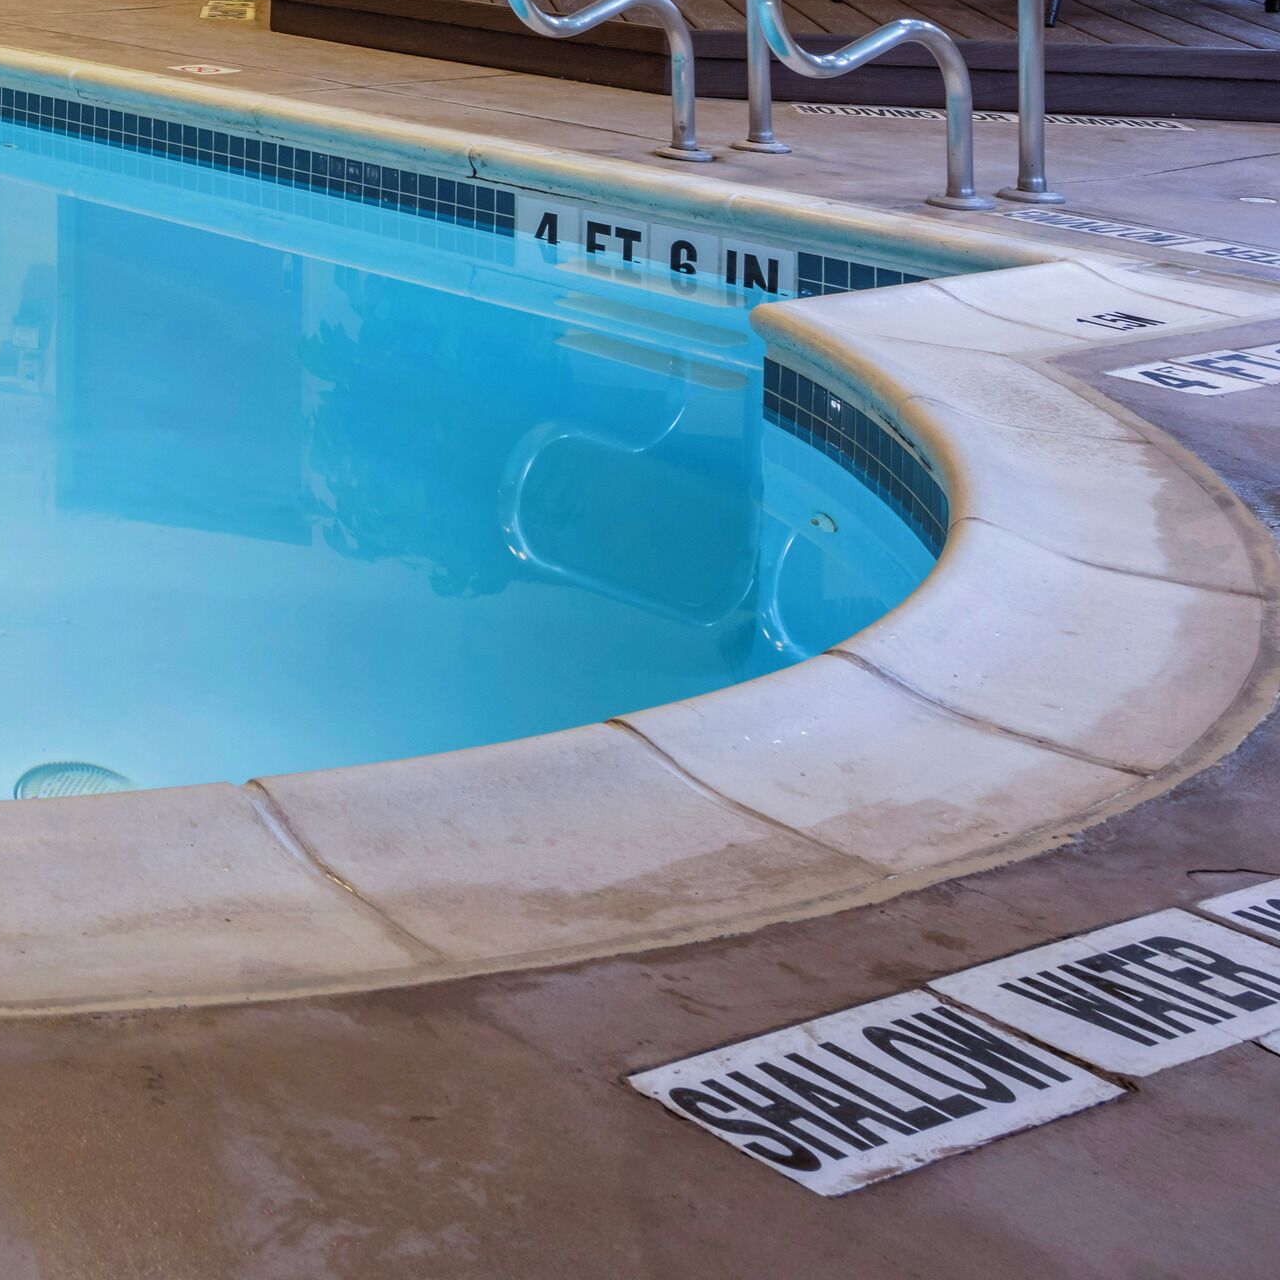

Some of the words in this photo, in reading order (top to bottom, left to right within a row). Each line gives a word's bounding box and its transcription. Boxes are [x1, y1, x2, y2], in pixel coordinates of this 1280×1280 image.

[797, 104, 835, 115] NO
[838, 105, 940, 120] DIVING
[971, 113, 1012, 122] OR
[1002, 209, 1130, 234] DIVING
[534, 212, 560, 245] 4
[670, 239, 698, 275] 6
[1204, 246, 1280, 265] TER
[668, 1006, 1073, 1173] SHALLOW
[998, 935, 1279, 1048] WATER
